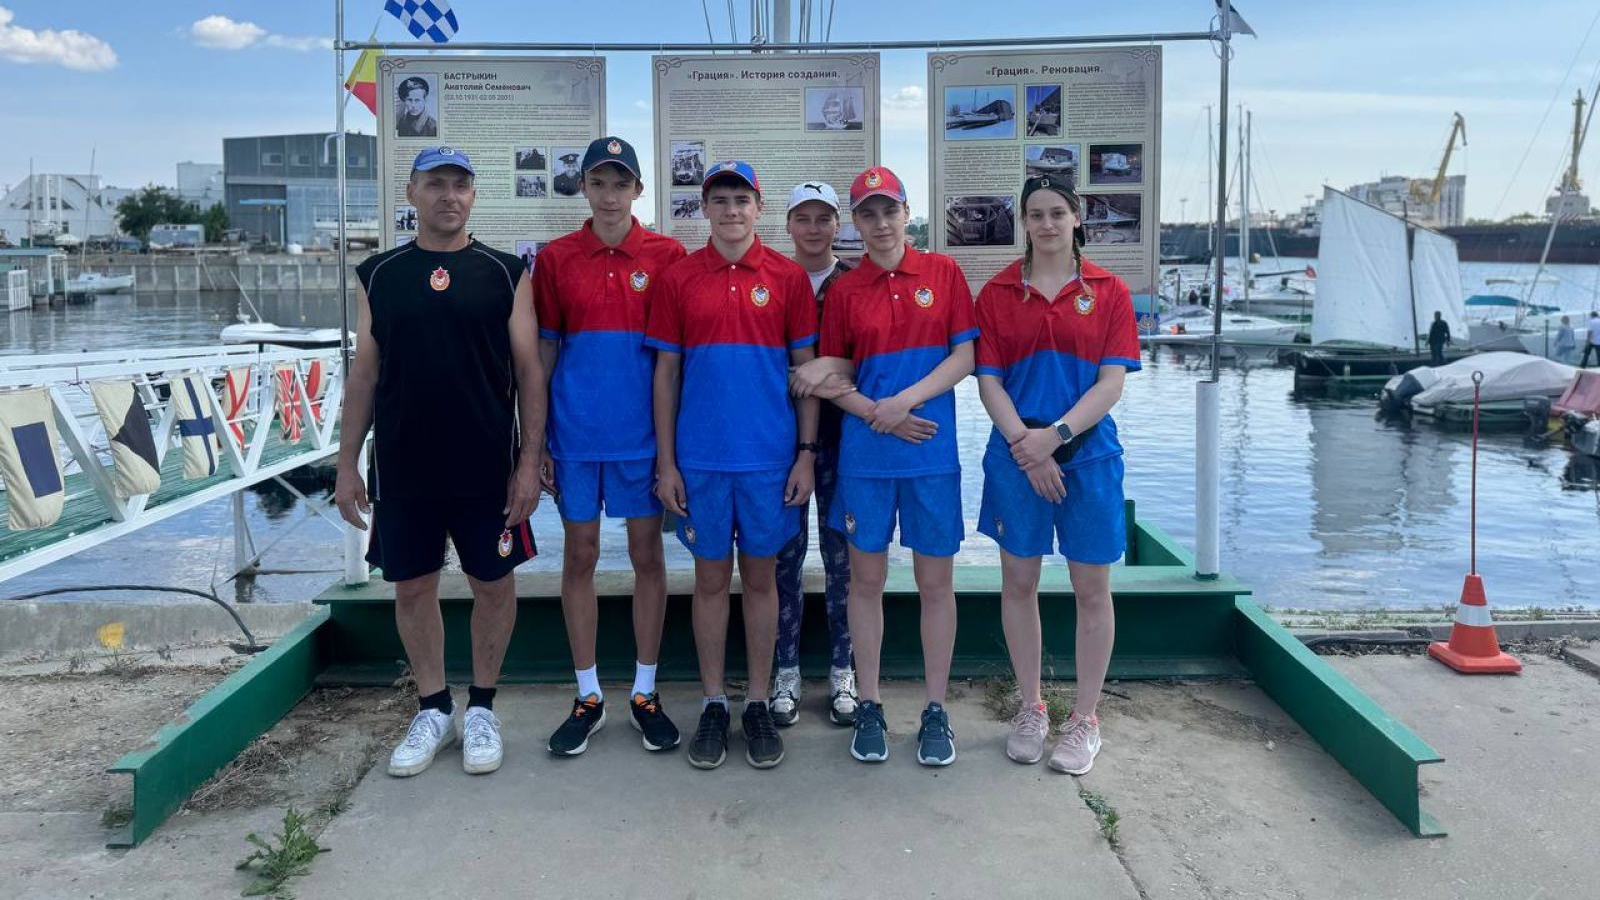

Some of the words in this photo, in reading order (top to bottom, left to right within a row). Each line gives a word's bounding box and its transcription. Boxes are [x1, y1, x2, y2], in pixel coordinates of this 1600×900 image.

[1041, 65, 1103, 76] Реновация.
[444, 72, 497, 80] БАСТРЫКИН
[741, 70, 784, 81] История
[788, 70, 841, 80] создания.
[444, 83, 483, 91] Анатолий
